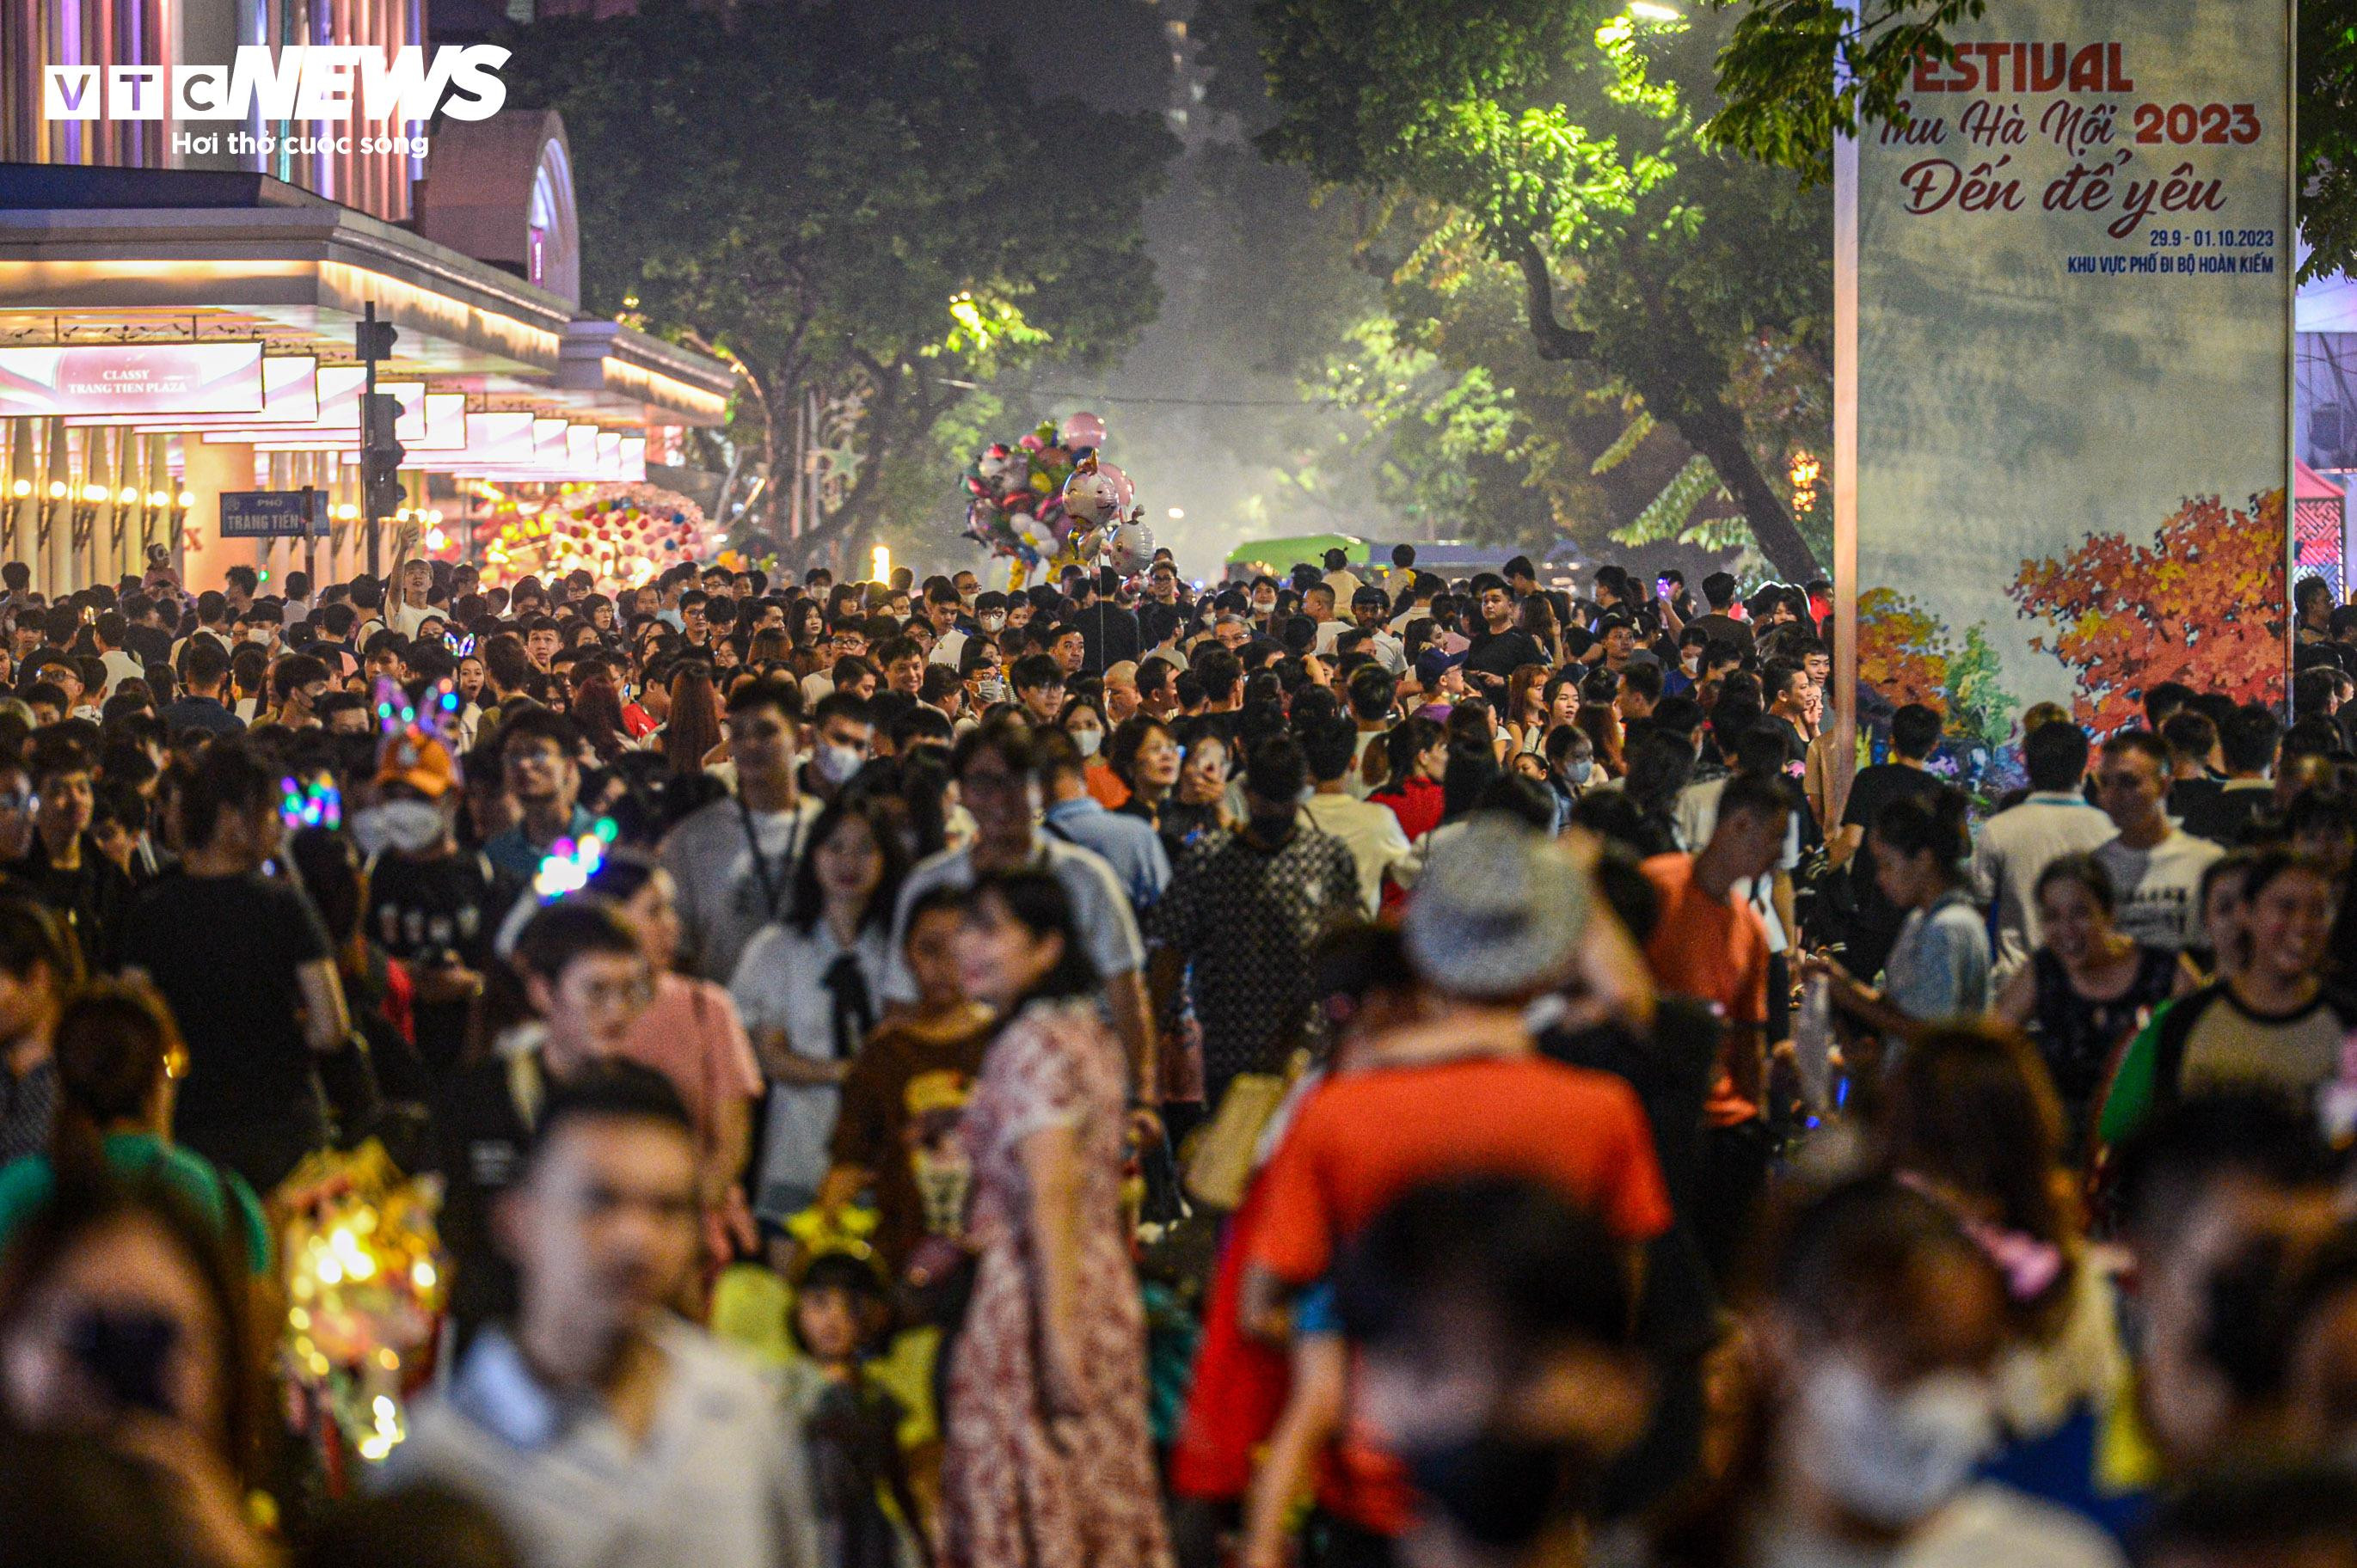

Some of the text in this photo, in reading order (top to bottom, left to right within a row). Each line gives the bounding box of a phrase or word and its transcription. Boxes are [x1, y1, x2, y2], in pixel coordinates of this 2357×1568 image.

[1892, 42, 2133, 92] ESTIVAL
[1960, 99, 2029, 147] Hà
[2040, 99, 2118, 157] Nội
[2133, 103, 2262, 144] 2023
[1900, 148, 2228, 239] Đến để yêu
[2151, 230, 2181, 247] 29.9
[2194, 230, 2274, 247] 01.10.2023
[2068, 251, 2274, 277] KHU VỰC PHỐ ĐI BỘ HOÀN KIẾM
[68, 382, 187, 395] TRANG TIEN PLAZA
[102, 370, 150, 381] CLASSY
